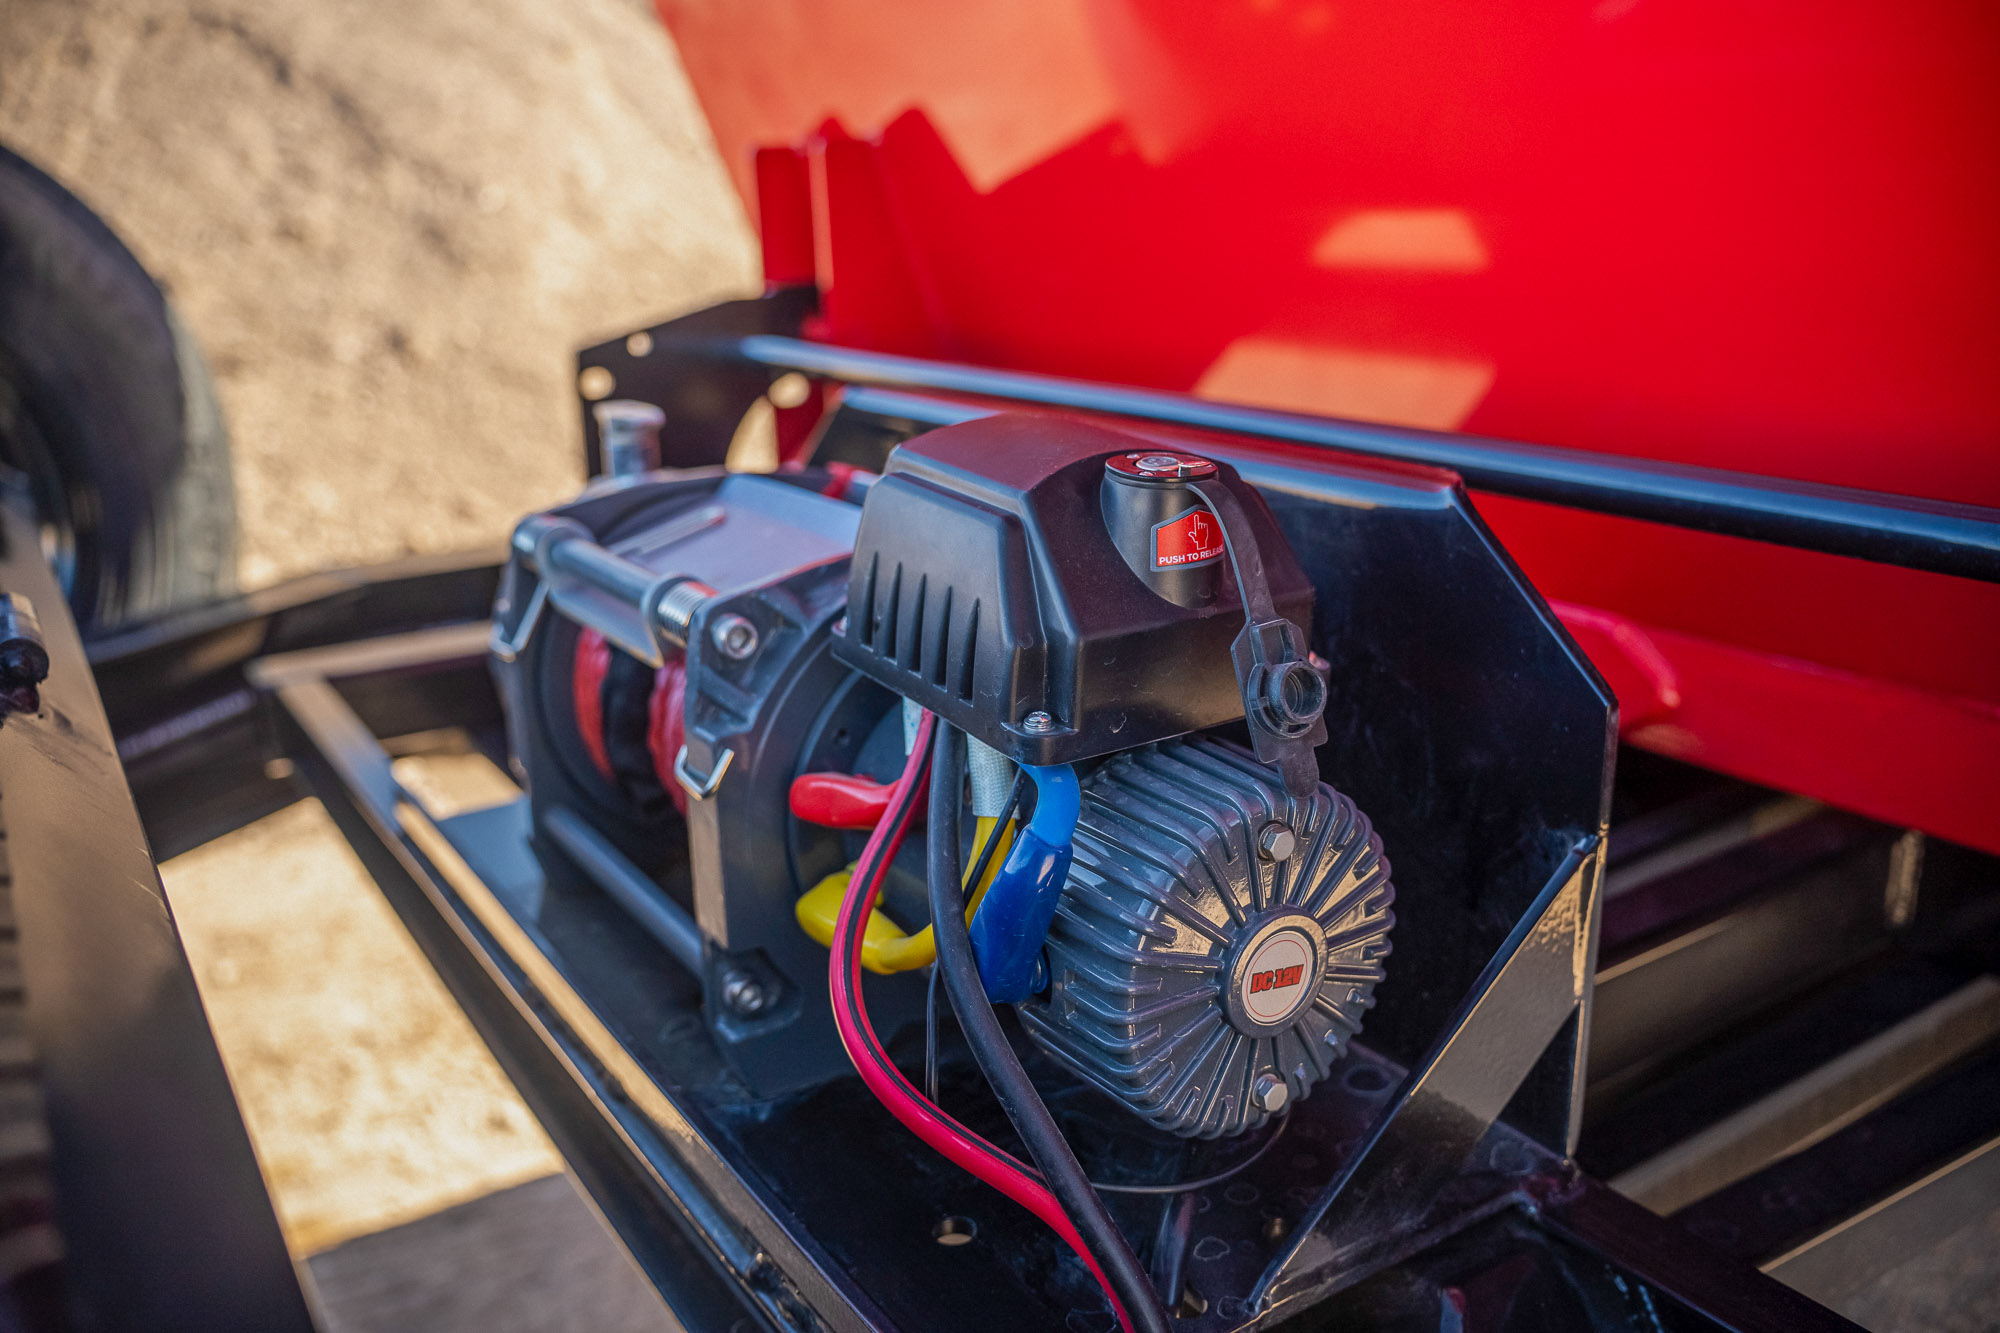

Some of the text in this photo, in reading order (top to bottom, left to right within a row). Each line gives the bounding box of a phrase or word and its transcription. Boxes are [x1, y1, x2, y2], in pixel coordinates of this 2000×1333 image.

[1159, 555, 1185, 565] PUSH
[1187, 552, 1199, 561] TO
[1250, 964, 1304, 994] DC 12V
